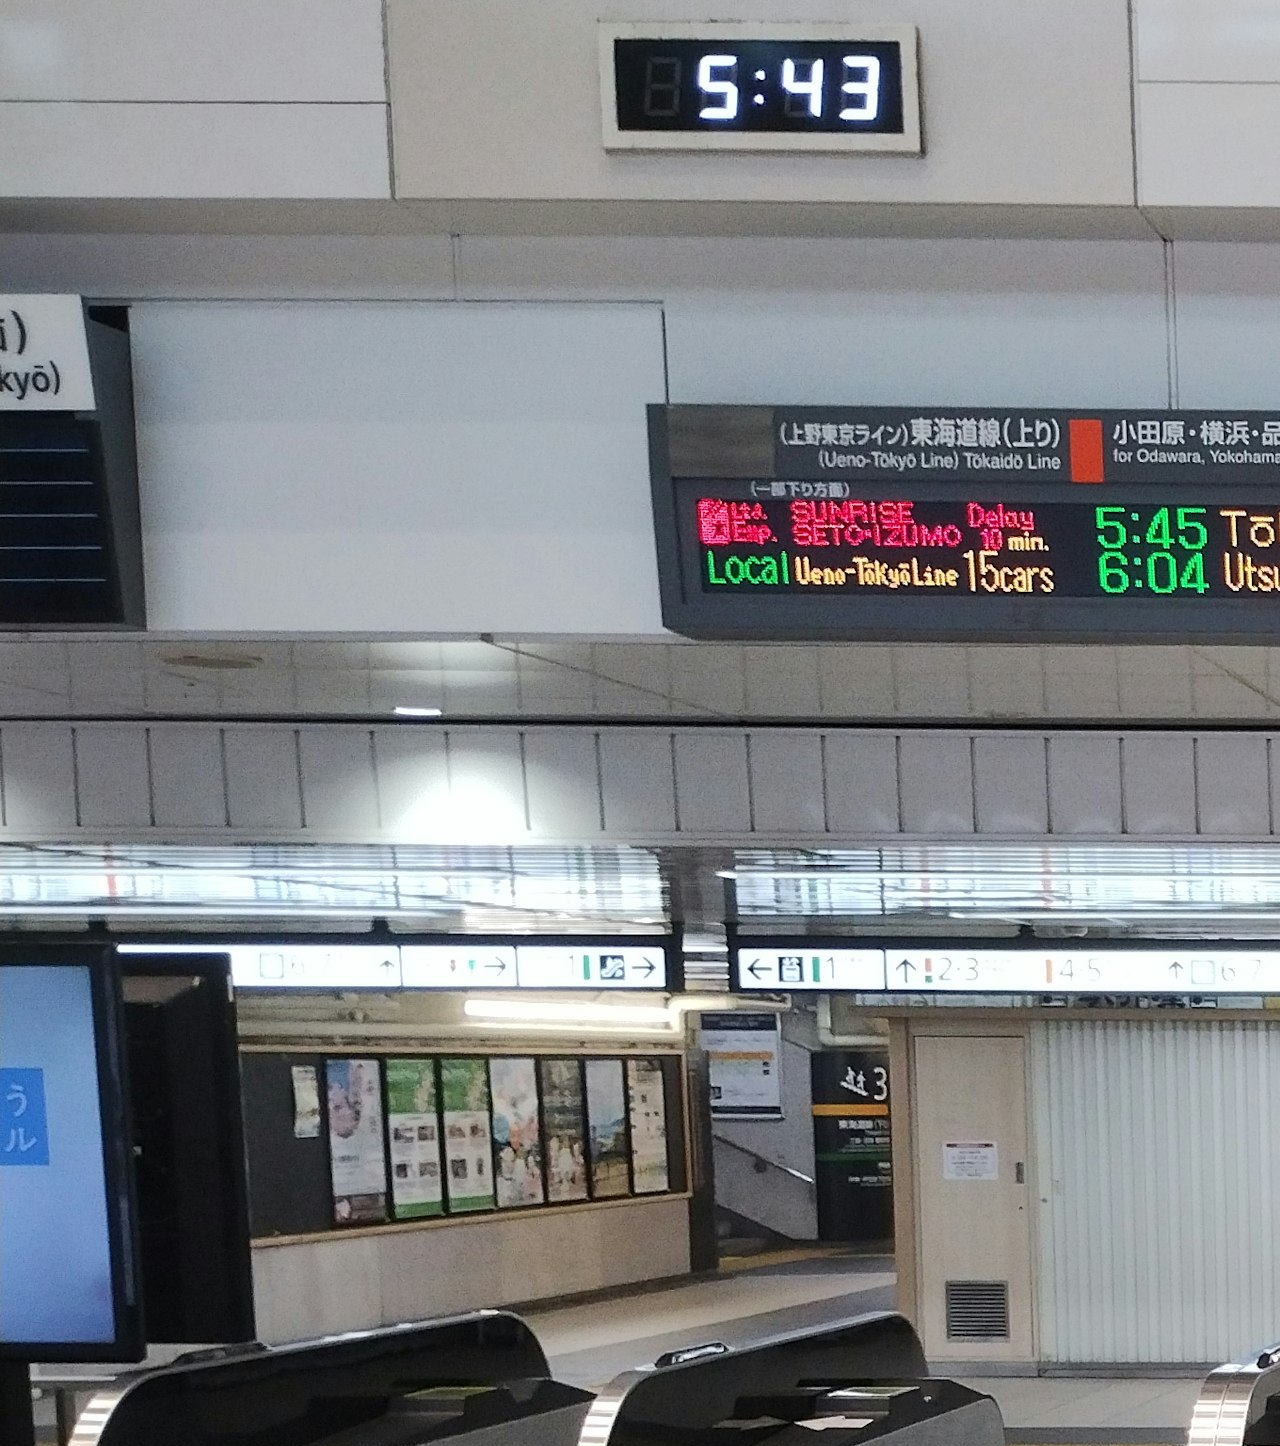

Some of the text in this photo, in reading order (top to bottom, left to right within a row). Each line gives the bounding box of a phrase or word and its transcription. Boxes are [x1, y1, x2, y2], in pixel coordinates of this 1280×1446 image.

[698, 54, 881, 121] 5:43
[921, 451, 959, 470] Line)
[1027, 452, 1062, 470] Line
[1113, 448, 1133, 463] for
[1136, 448, 1206, 465] Odawara,
[790, 499, 915, 525] SUNRISE
[966, 501, 1035, 531] Delay
[1095, 506, 1209, 551] 5:45
[1007, 531, 1050, 551] min.
[706, 550, 790, 585] Local
[912, 557, 960, 587] Line
[1098, 551, 1211, 595] 6:04
[873, 1066, 888, 1101] 3
[5, 1084, 27, 1118] う
[4, 1127, 38, 1153] ル
